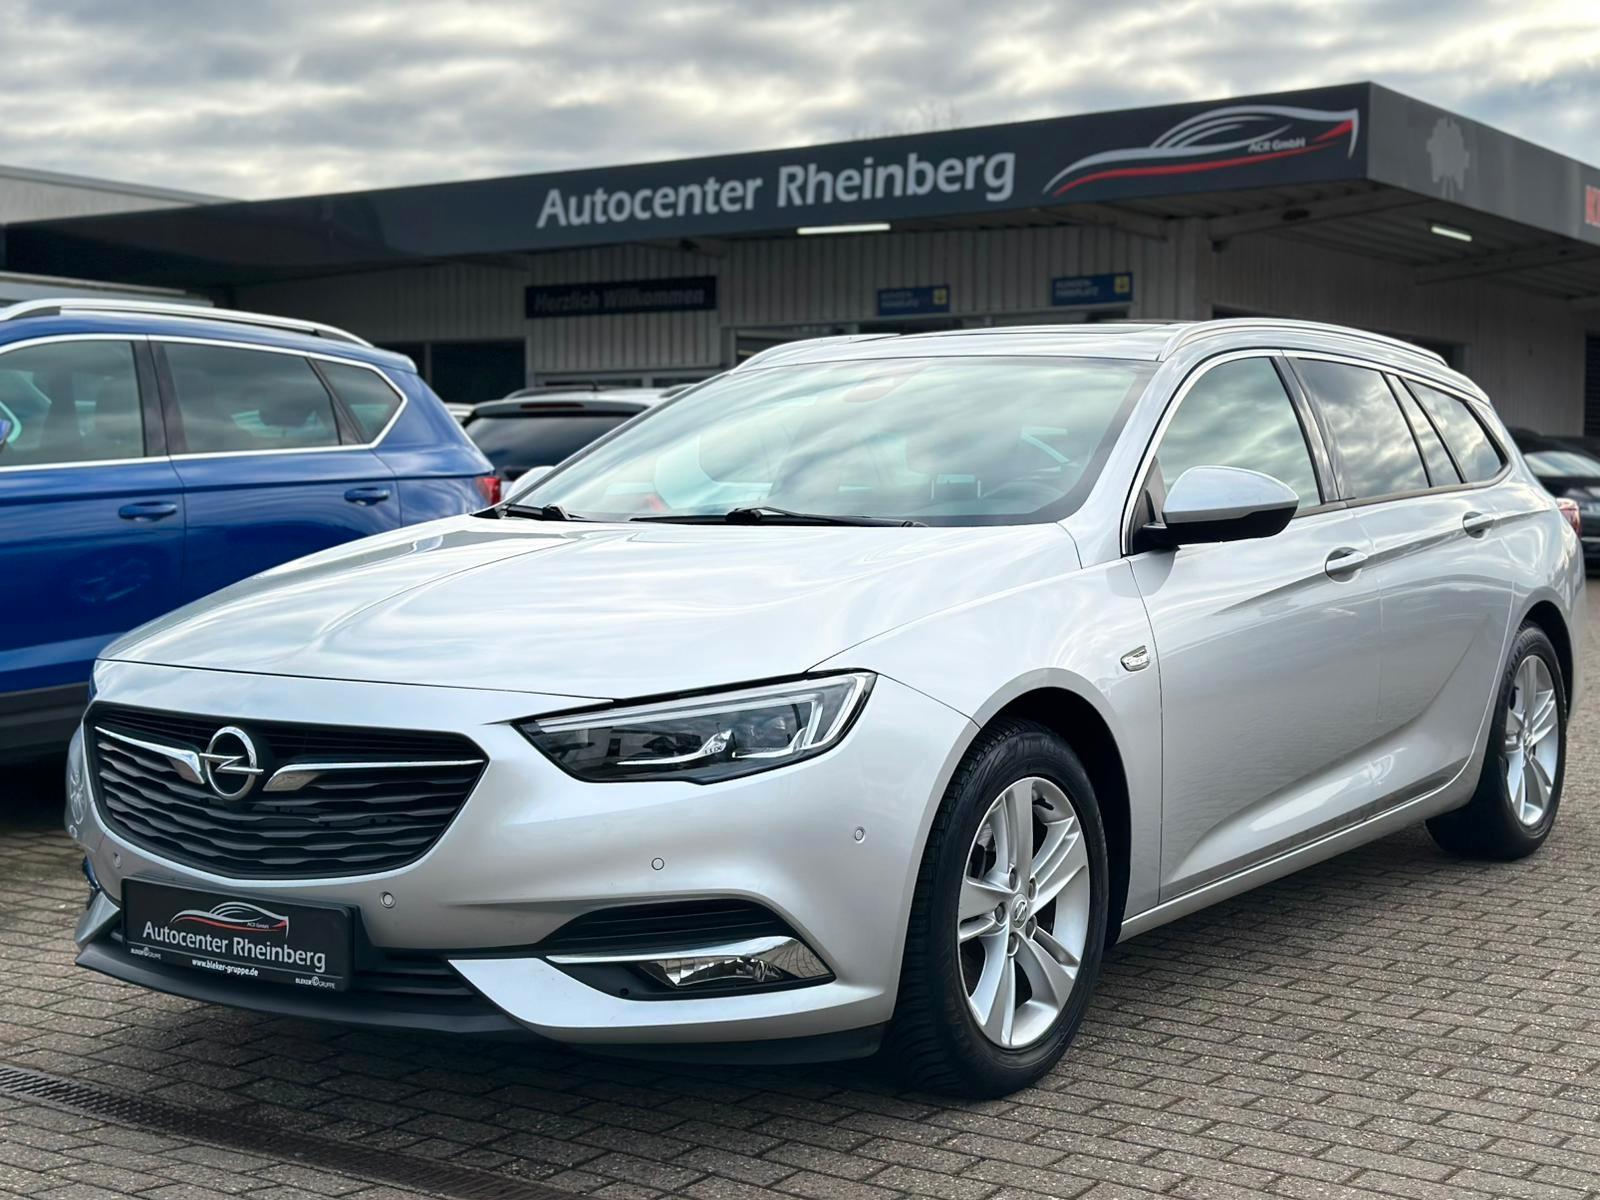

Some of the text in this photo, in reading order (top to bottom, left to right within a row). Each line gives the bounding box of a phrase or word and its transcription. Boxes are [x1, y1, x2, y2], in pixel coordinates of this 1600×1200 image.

[536, 152, 1016, 229] Autocenter Rheinberg
[142, 920, 229, 954] Autocenter
[233, 937, 326, 973] Rheinberg
